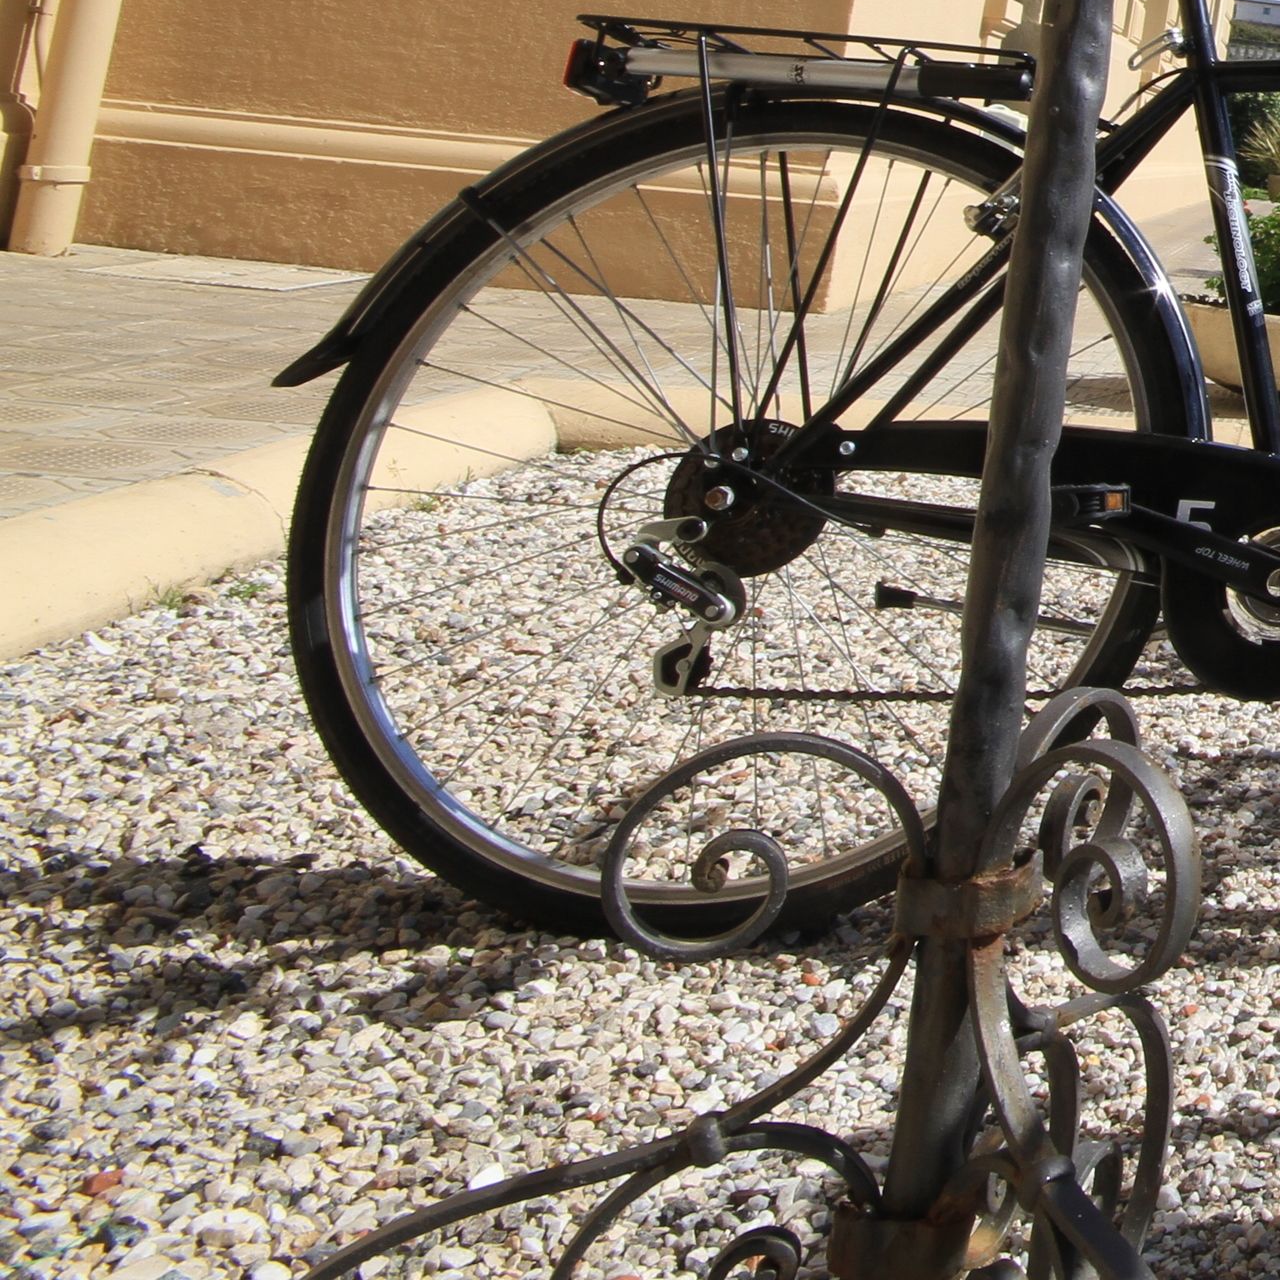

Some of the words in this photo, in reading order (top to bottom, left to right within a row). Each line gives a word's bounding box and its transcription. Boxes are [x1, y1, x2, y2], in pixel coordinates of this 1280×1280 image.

[1223, 190, 1252, 293] TECHNOLOGY
[1194, 546, 1217, 559] TOP
[1217, 552, 1251, 571] WHEEL
[652, 573, 700, 602] SHIMANO
